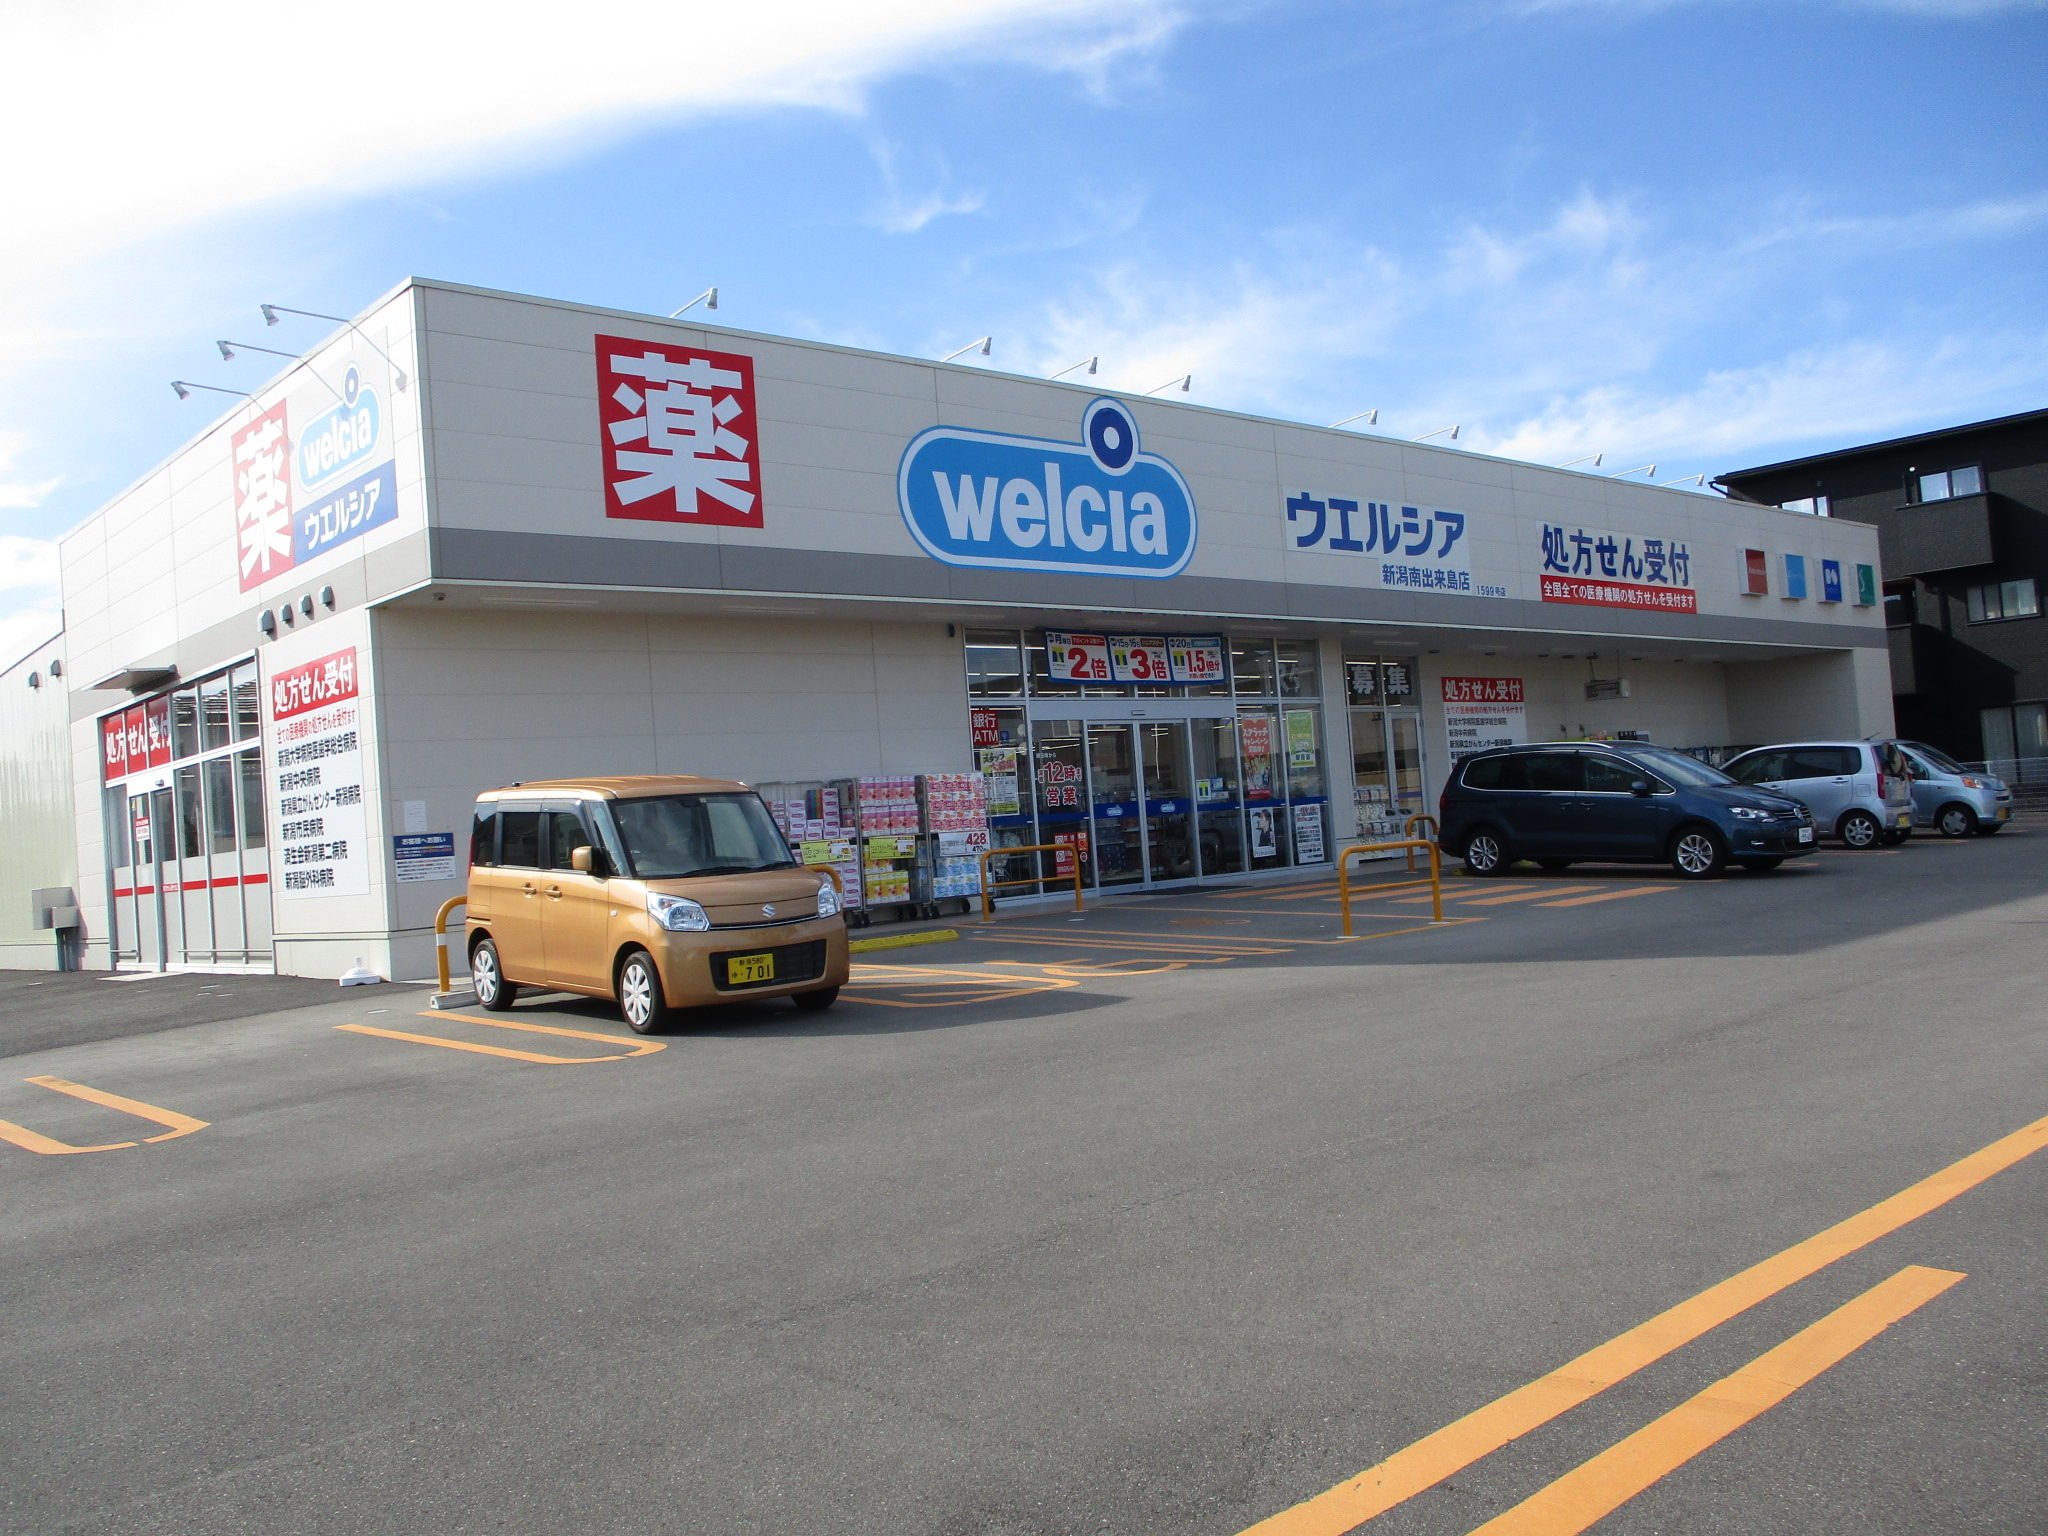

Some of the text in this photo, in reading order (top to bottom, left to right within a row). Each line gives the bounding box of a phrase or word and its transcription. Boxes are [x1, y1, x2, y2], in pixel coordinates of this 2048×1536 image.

[303, 366, 373, 479] welcia
[607, 350, 757, 515] 薬
[235, 418, 293, 581] 薬
[932, 406, 1169, 556] welcia
[304, 478, 381, 551] ウエルシア
[1286, 491, 1465, 559] ウエルシア
[1382, 563, 1471, 592] 新潟南出来島店
[1541, 523, 1690, 587] 処方せん受付
[1543, 580, 1694, 609] 全国全ての医療機関の処方せんを受付ます
[274, 656, 353, 714] 処方せん受付
[1445, 679, 1521, 701] 処方せん受付
[106, 712, 171, 764] 処方せん受付
[972, 713, 997, 728] 銀行
[973, 729, 999, 743] ATM
[1046, 786, 1077, 807] 営業
[965, 832, 987, 846] 428
